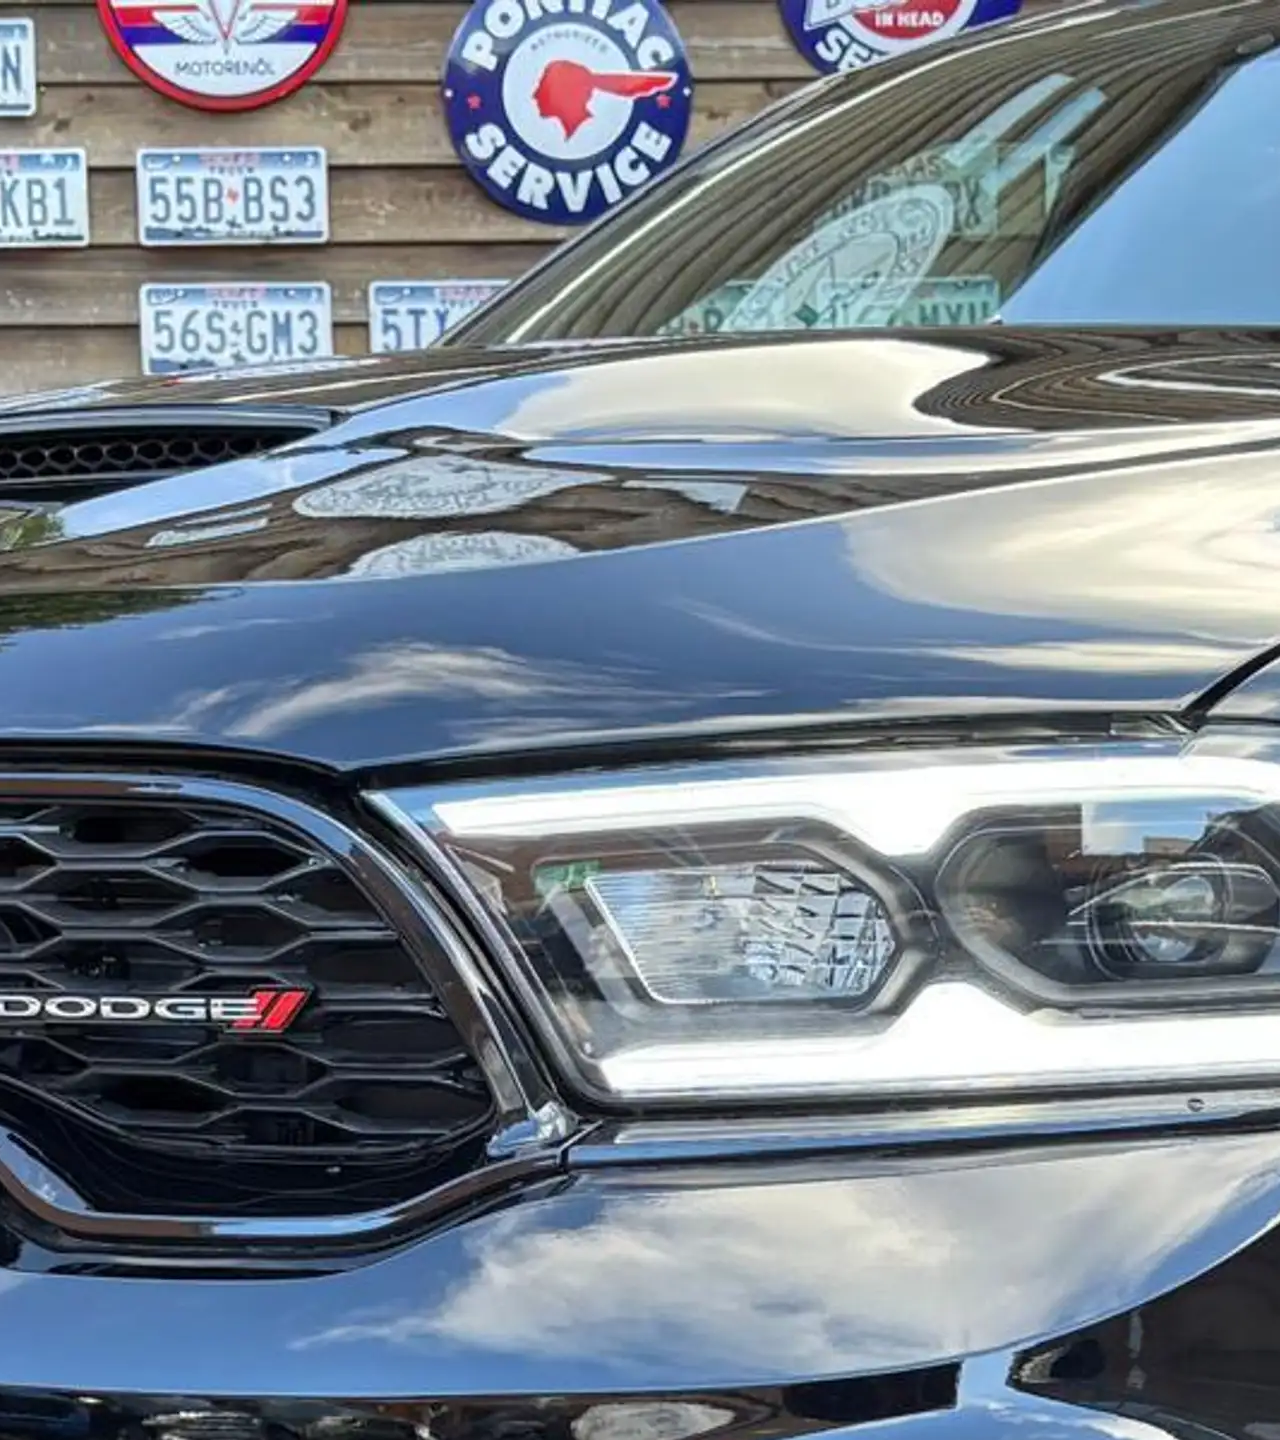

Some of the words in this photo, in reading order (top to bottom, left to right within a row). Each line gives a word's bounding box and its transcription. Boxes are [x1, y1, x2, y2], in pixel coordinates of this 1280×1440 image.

[874, 12, 893, 27] IN
[896, 11, 944, 27] HEAD
[176, 58, 275, 76] MOTORENÖL
[815, 27, 882, 72] SE
[465, 122, 672, 212] SERVICE
[0, 177, 75, 228] KB1
[150, 176, 224, 224] 55B
[243, 175, 316, 223] BS3
[154, 309, 227, 354] 56S
[246, 310, 318, 356] GM3
